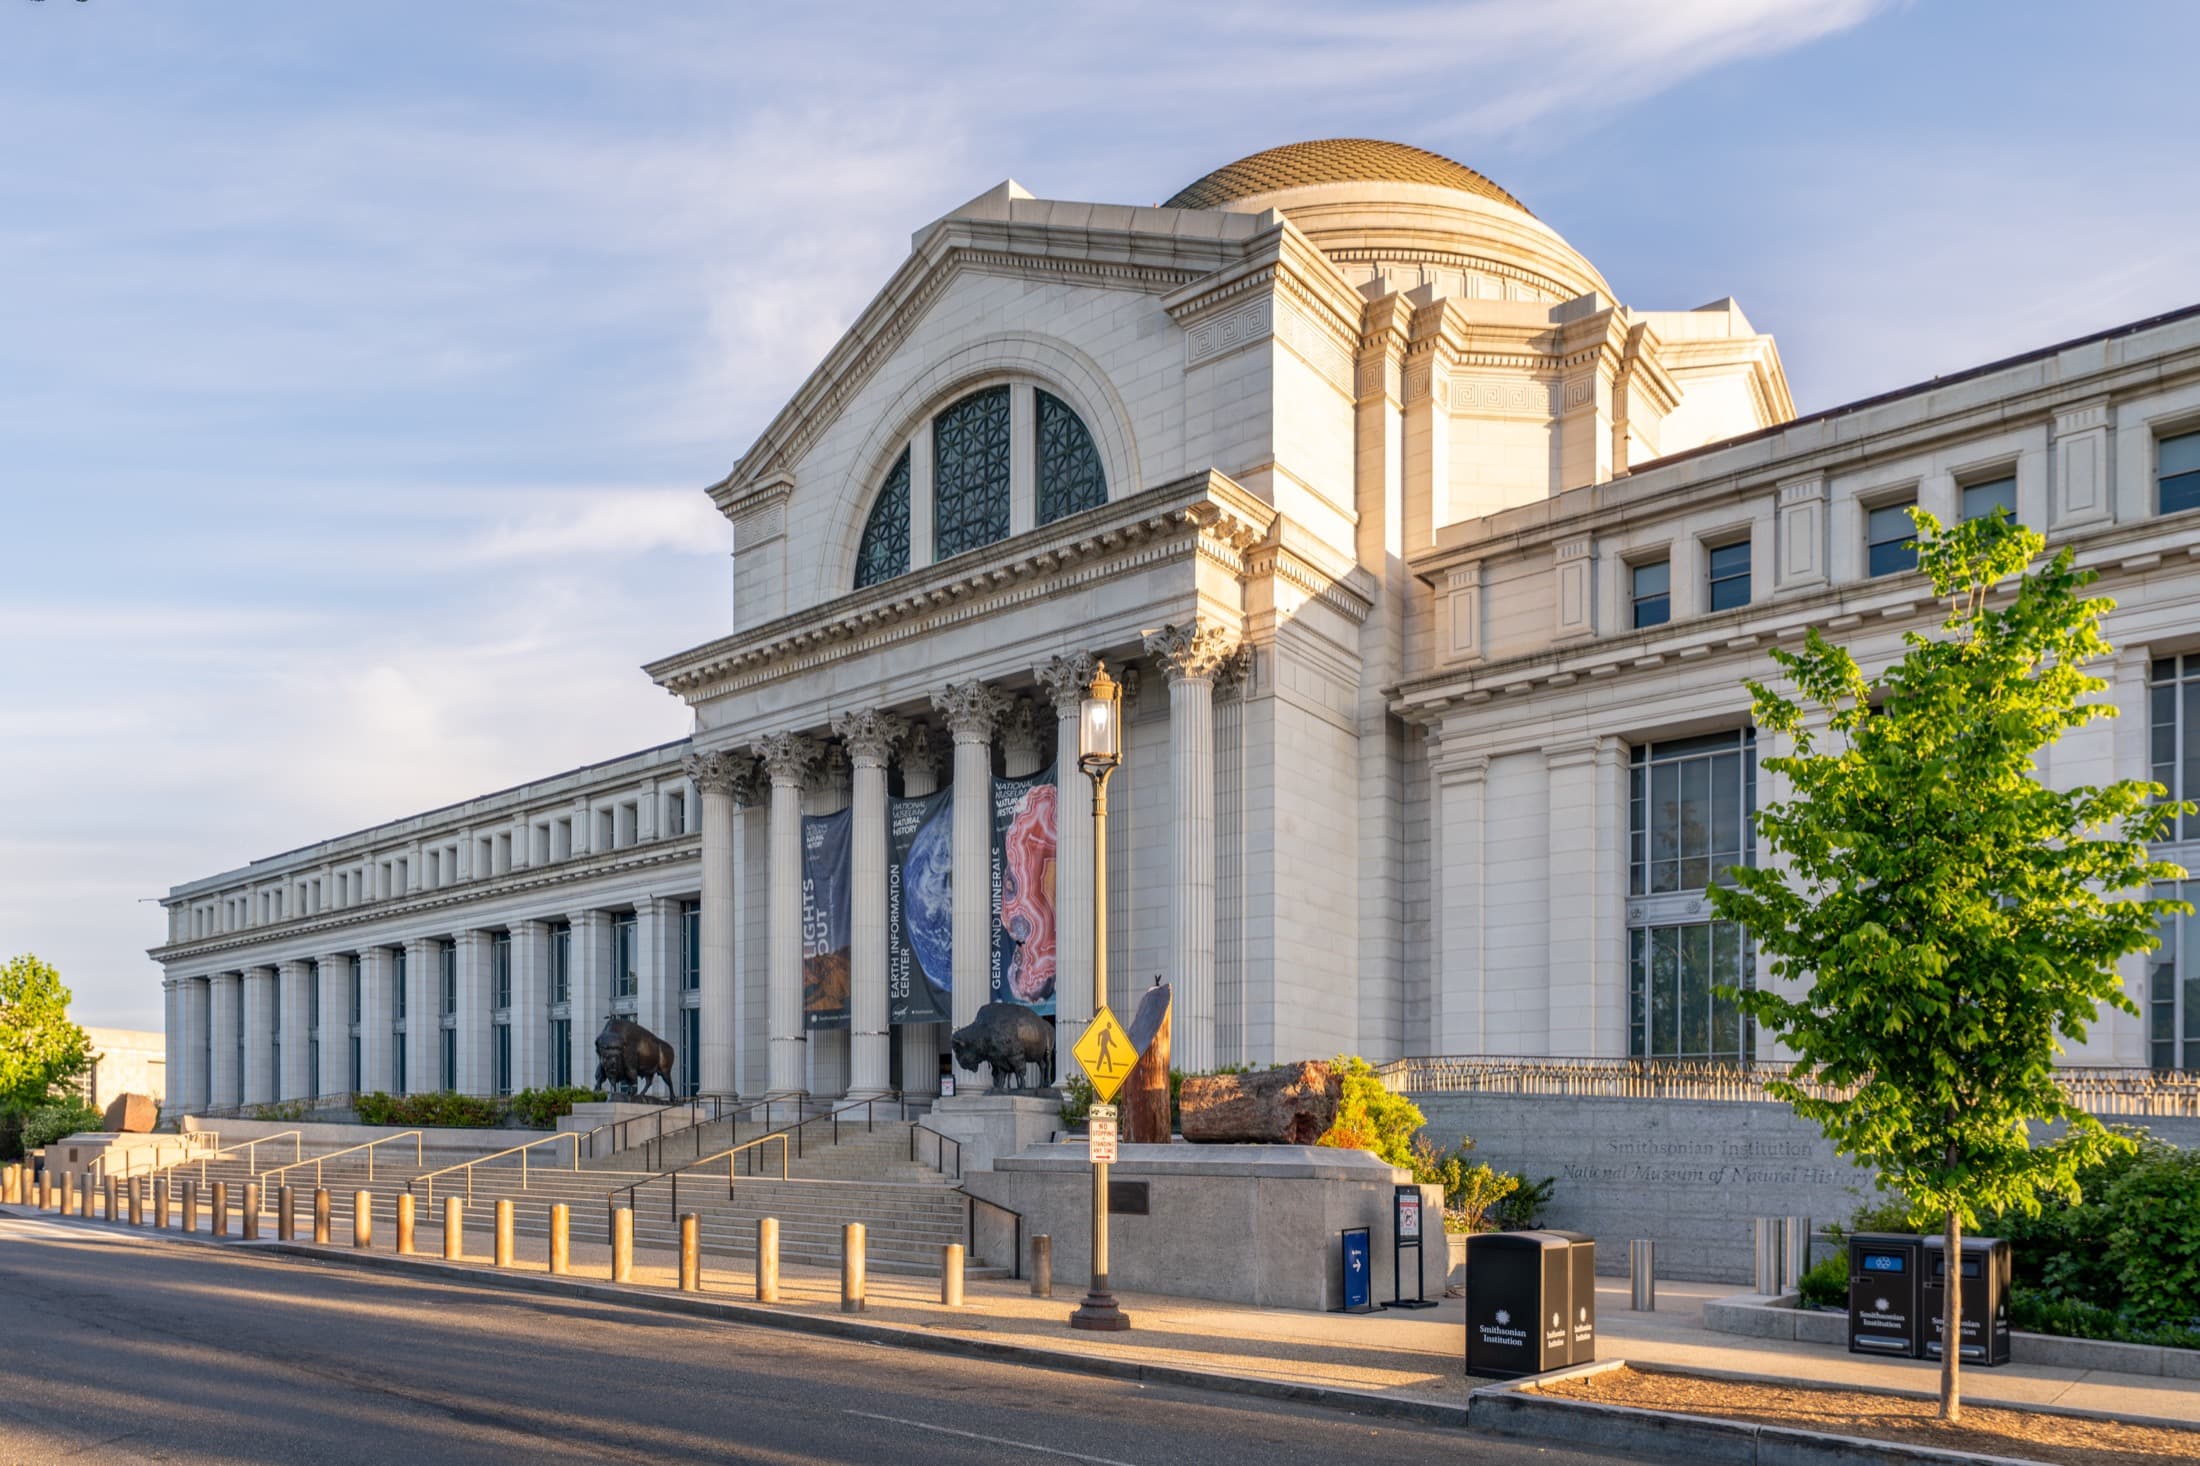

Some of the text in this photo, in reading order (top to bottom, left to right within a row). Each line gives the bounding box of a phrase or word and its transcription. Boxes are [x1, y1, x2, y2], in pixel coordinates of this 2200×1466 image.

[893, 816, 920, 827] NATURAL
[893, 824, 917, 836] HISTORY
[803, 878, 816, 959] LIGHTS
[992, 847, 1001, 989] GEMS AND MINERALS
[817, 908, 829, 956] OUT
[890, 864, 900, 998] EARTH INFORMATION
[900, 948, 910, 998] CENTER
[1608, 1139, 1813, 1156] Smithsonian Institution
[1562, 1164, 1873, 1187] National Museum of Natural History
[1479, 1324, 1527, 1338] Smithsonian
[1483, 1334, 1523, 1347] Institution
